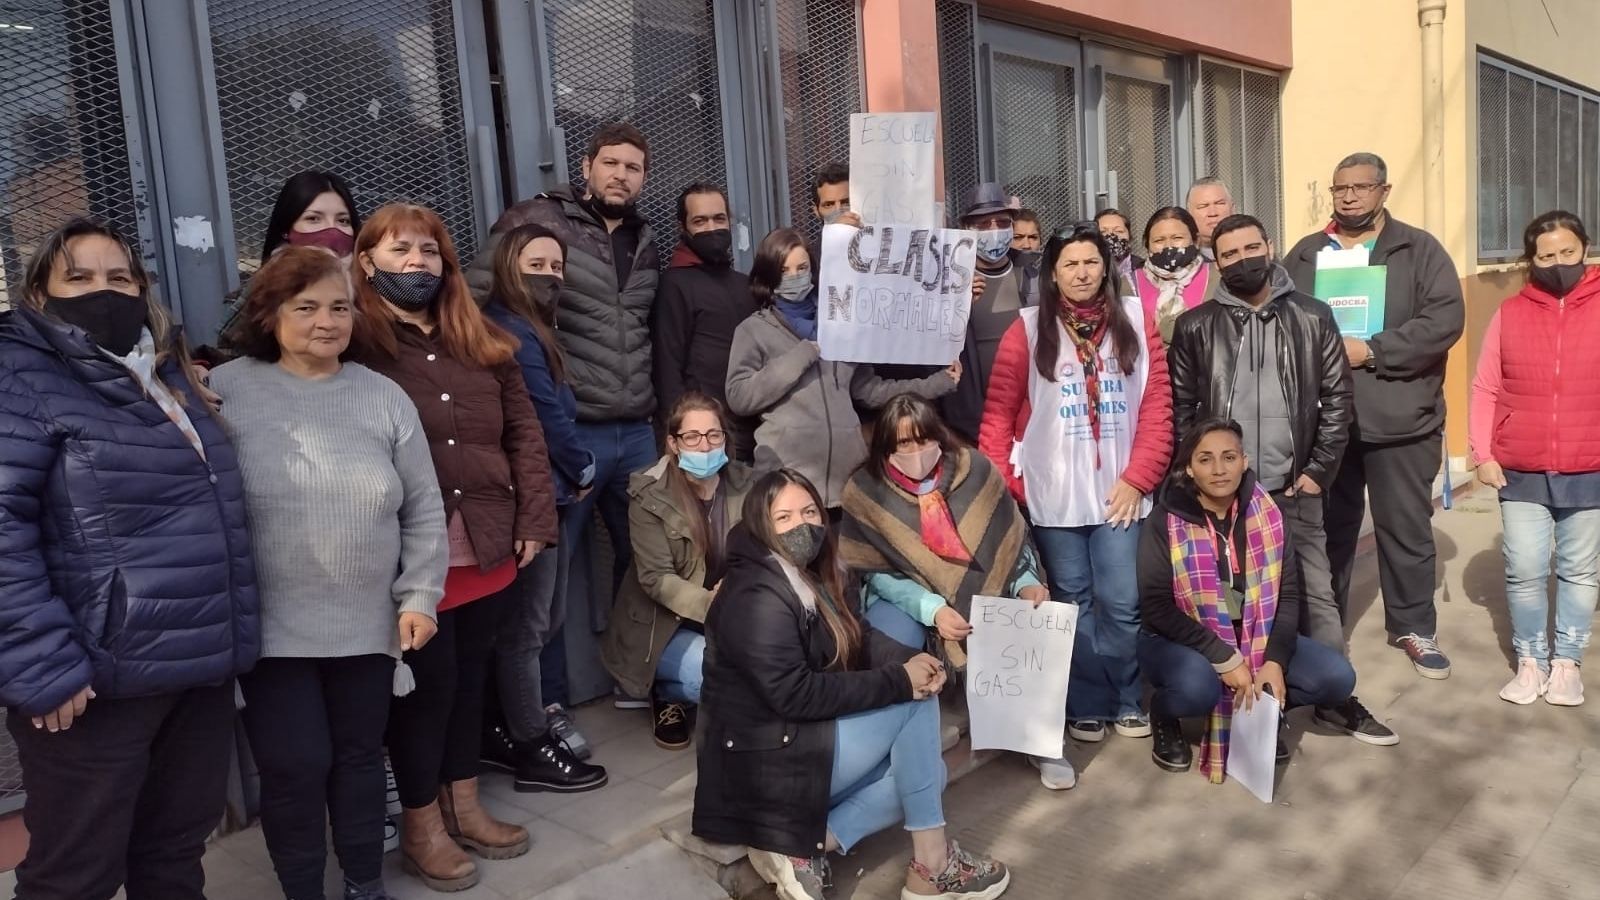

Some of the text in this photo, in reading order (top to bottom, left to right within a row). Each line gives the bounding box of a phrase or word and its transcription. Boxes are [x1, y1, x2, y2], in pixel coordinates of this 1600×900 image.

[862, 190, 915, 225] GAS
[848, 226, 974, 294] CLASES
[827, 285, 969, 342] NORMALES
[1061, 379, 1124, 397] SUBA
[1060, 401, 1127, 418] QUIMES
[981, 604, 1073, 634] ESCUELA
[1001, 644, 1045, 671] SIN
[974, 670, 1023, 697] GAS
